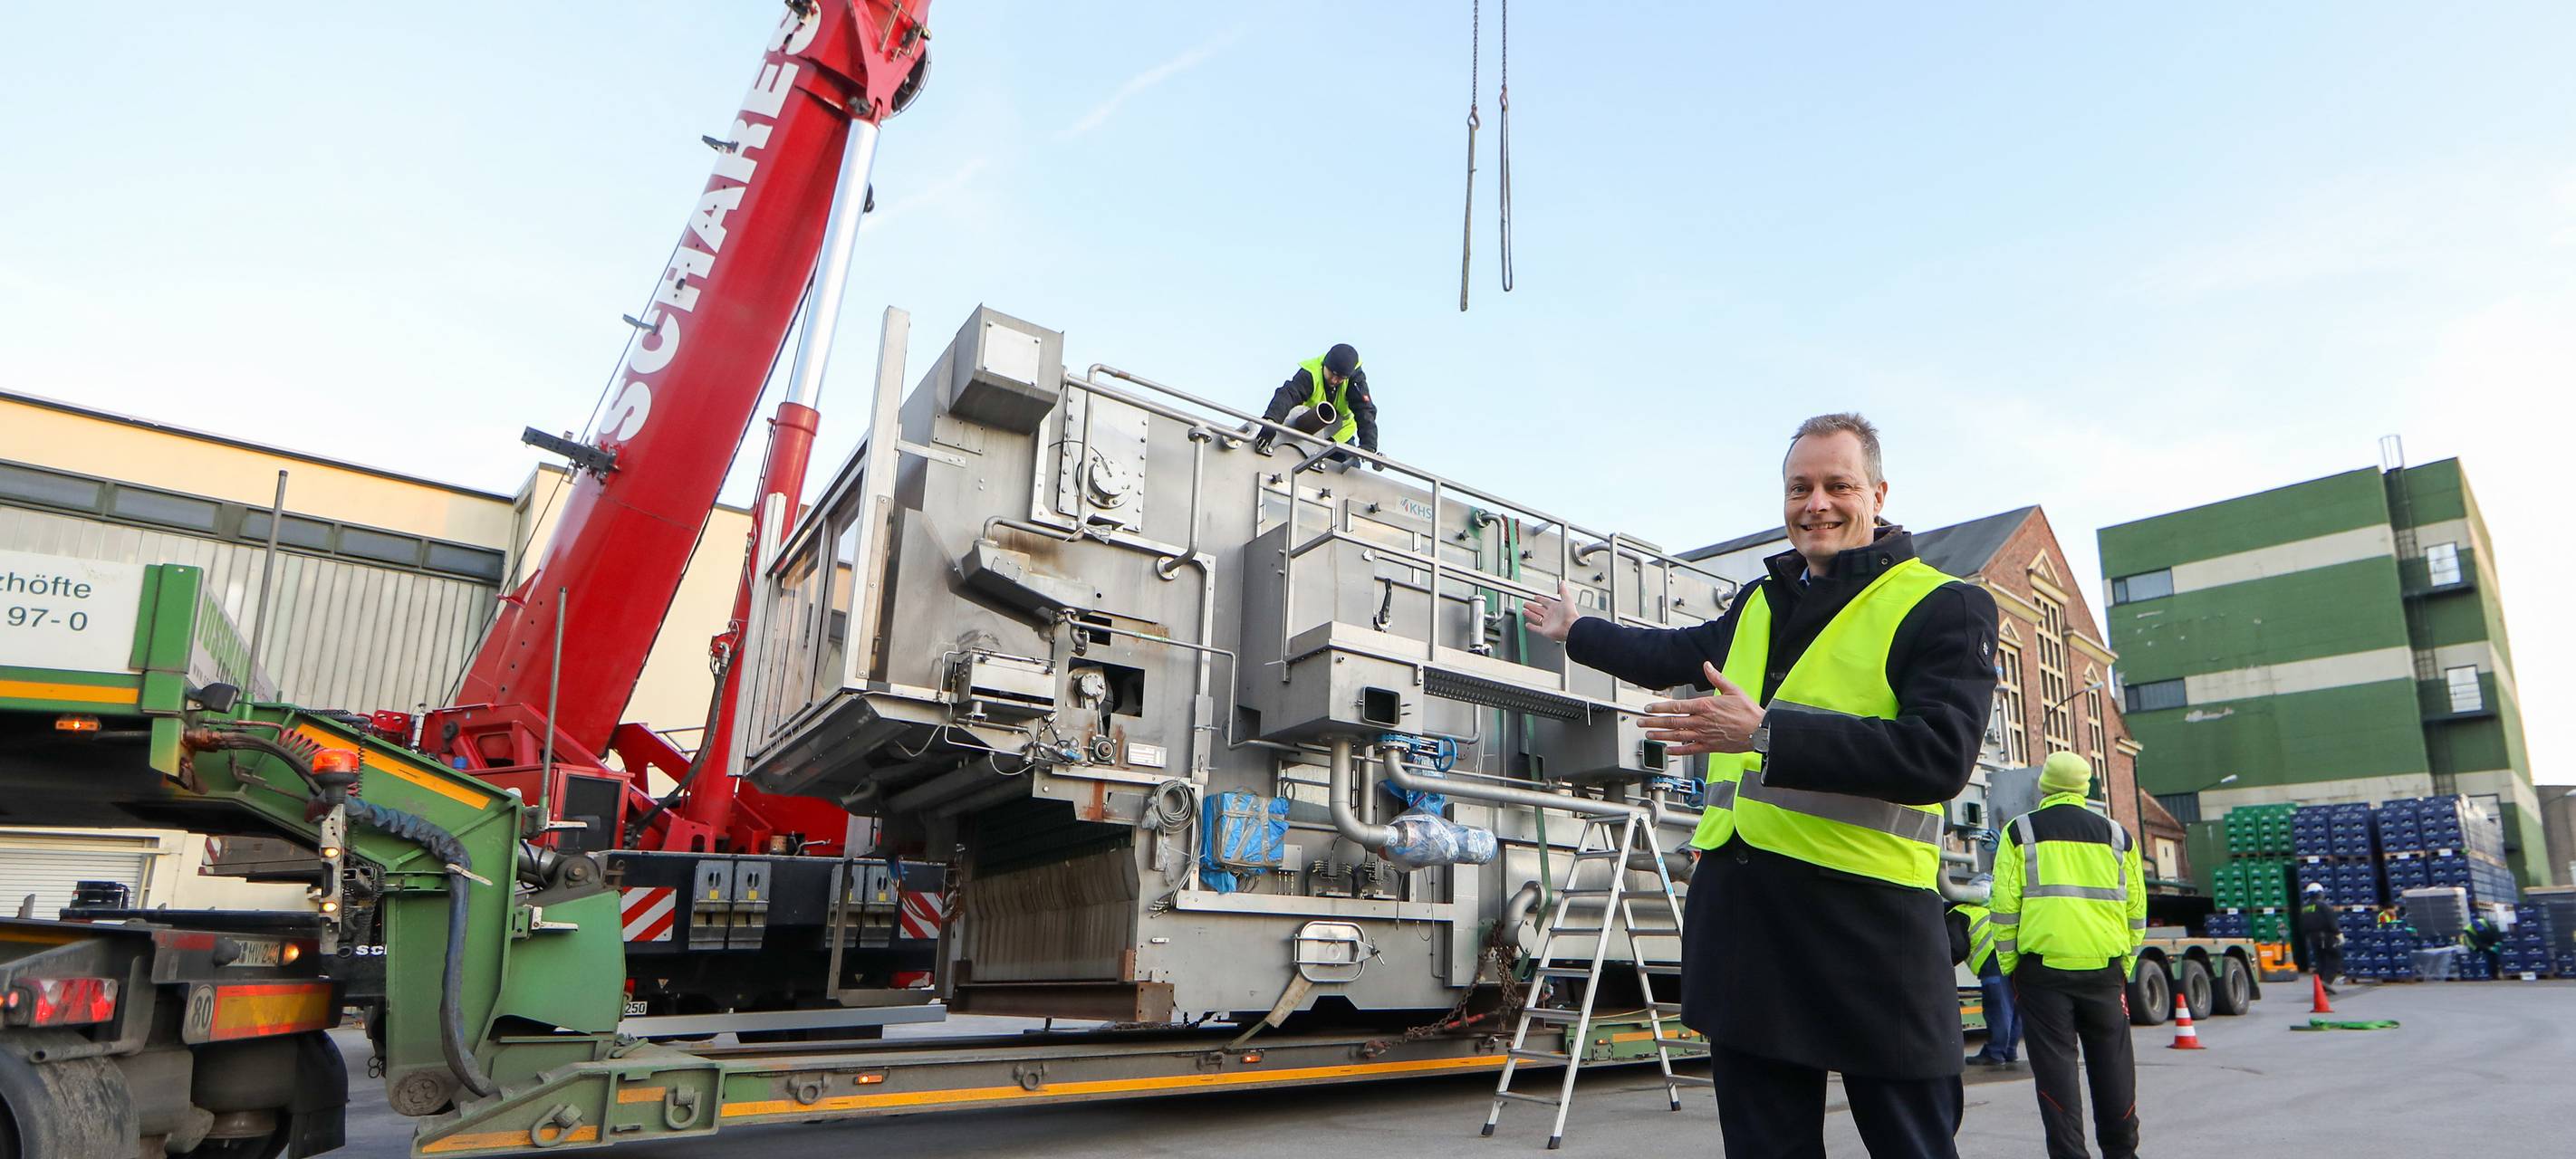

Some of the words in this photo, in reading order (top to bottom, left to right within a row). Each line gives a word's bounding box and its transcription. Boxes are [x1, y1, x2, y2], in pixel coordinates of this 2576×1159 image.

[600, 0, 822, 442] SCHARES
[1409, 502, 1432, 520] KHS
[355, 944, 387, 955] SC
[191, 995, 212, 1030] 80
[625, 1002, 646, 1014] 250
